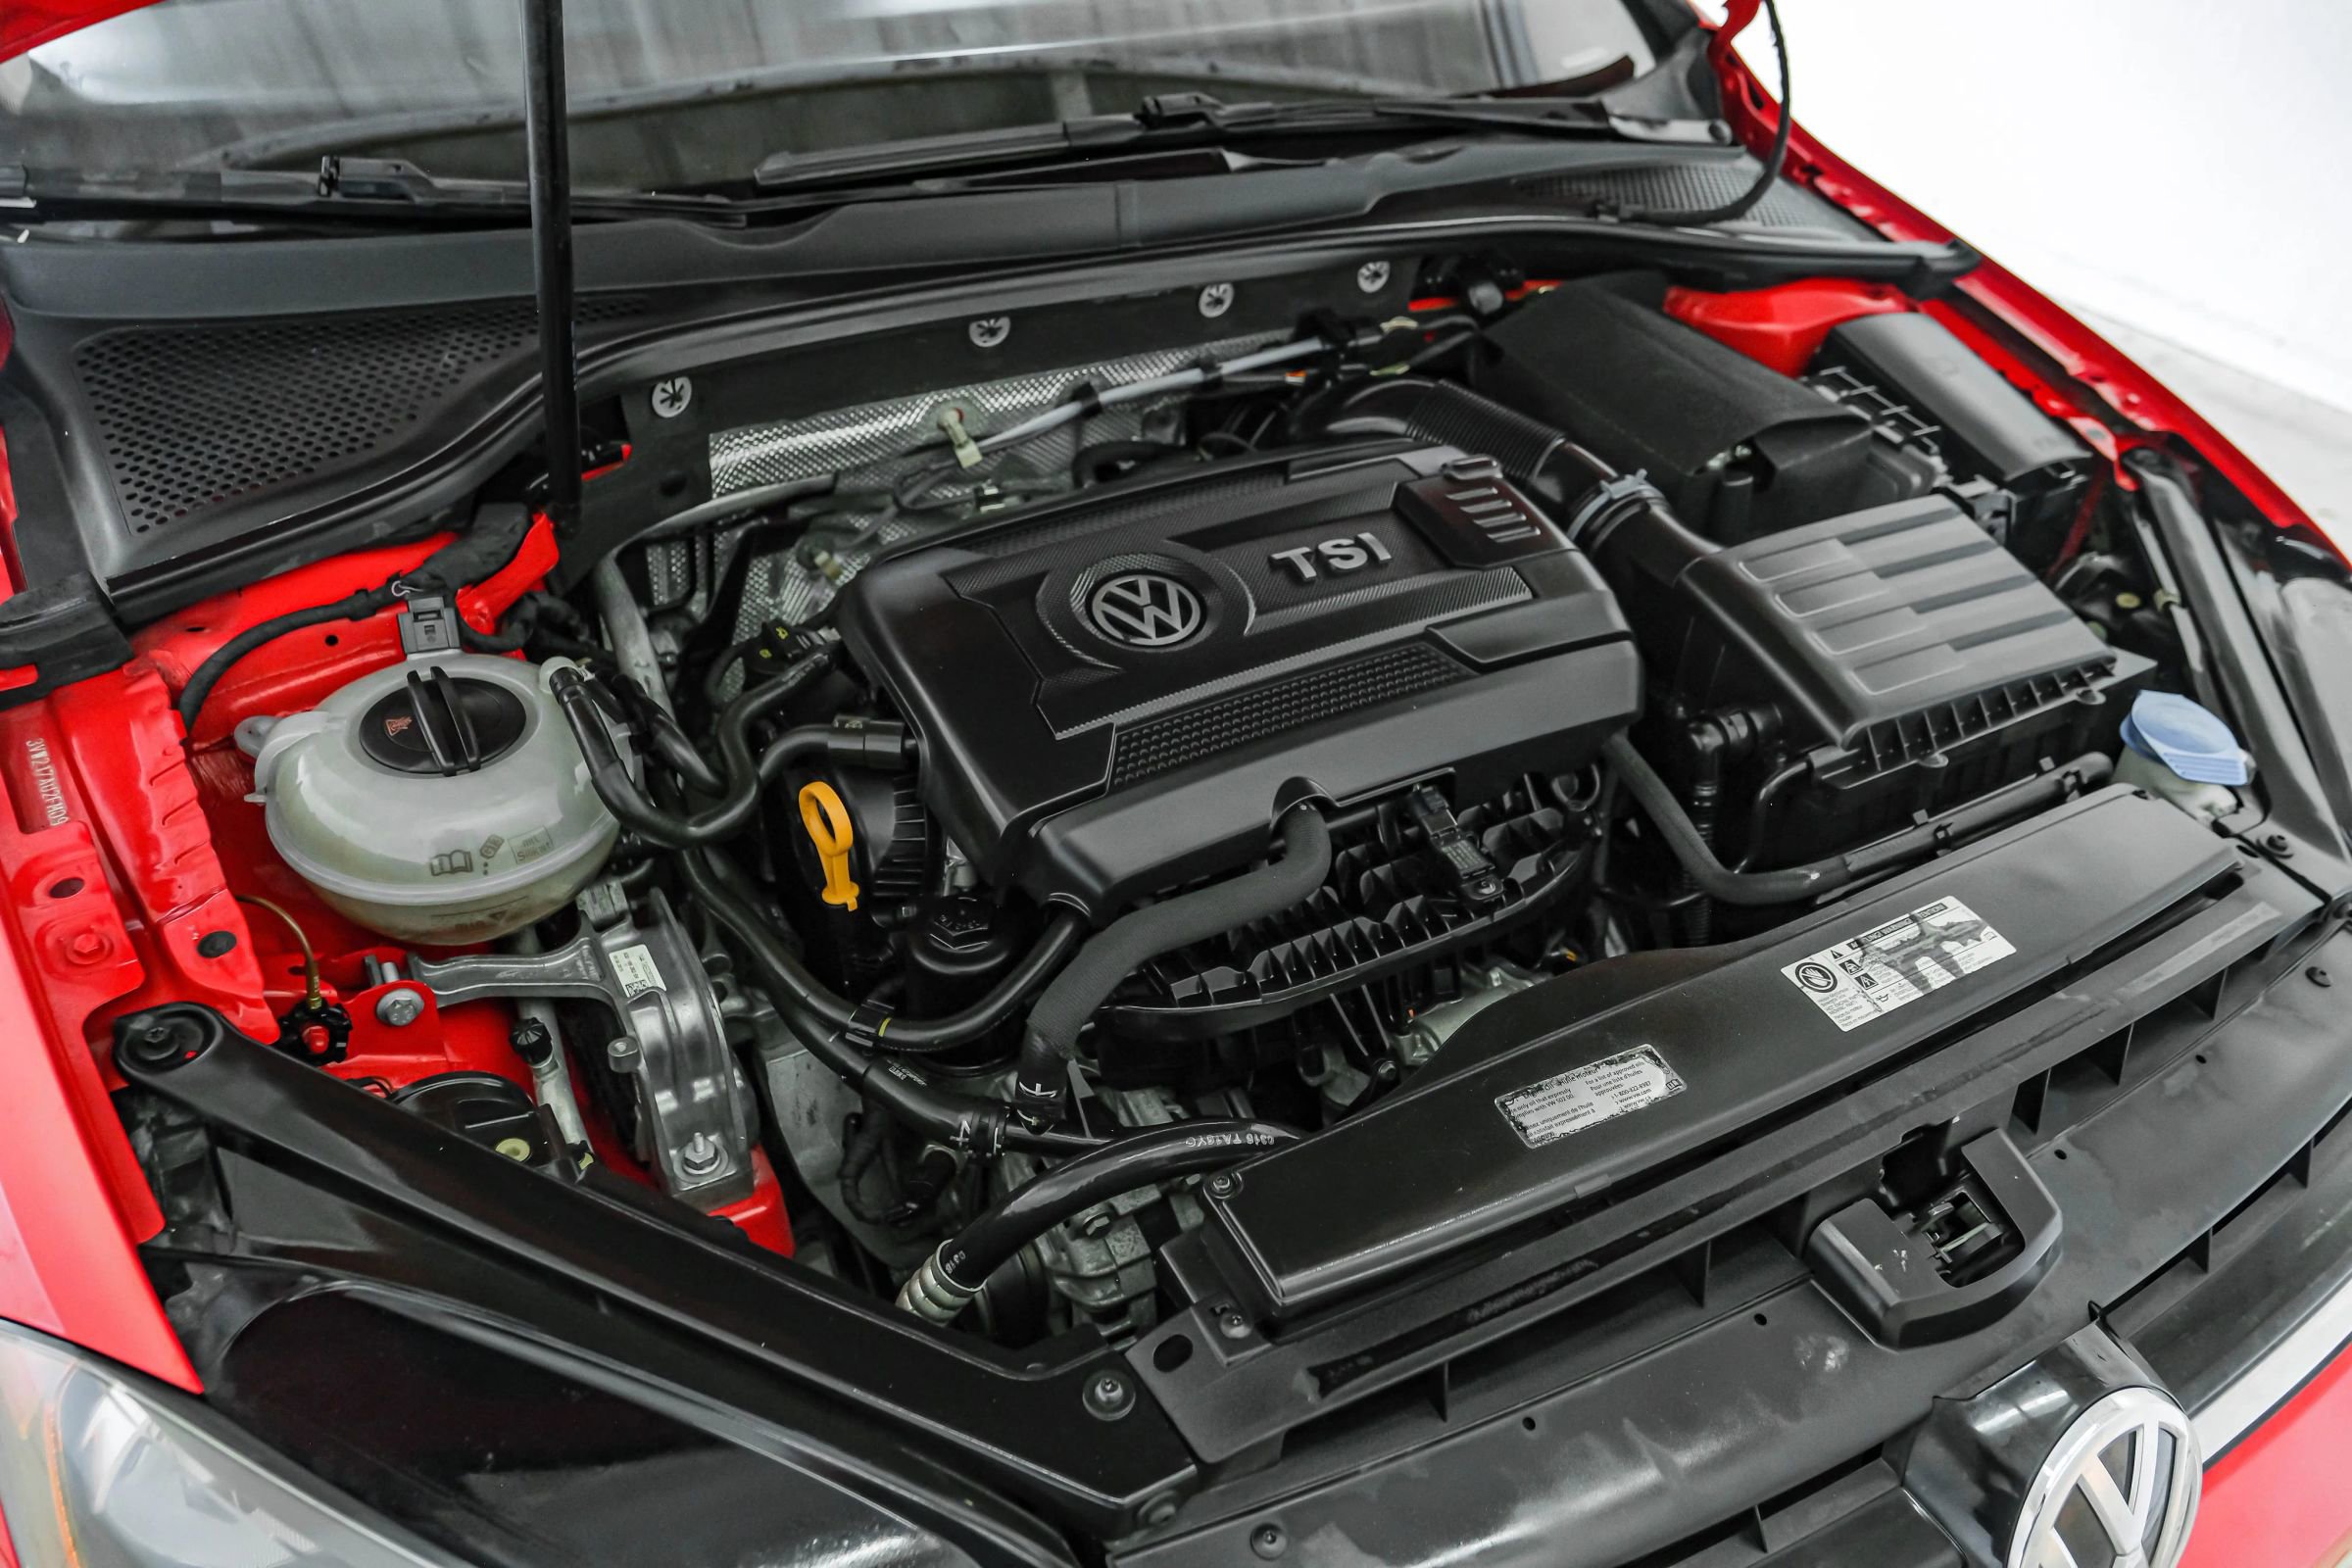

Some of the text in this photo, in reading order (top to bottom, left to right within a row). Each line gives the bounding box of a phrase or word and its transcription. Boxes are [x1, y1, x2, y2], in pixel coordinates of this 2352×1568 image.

[1271, 532, 1393, 581] TSI
[1612, 1063, 1636, 1076] approved
[1547, 1088, 1572, 1100] expressly
